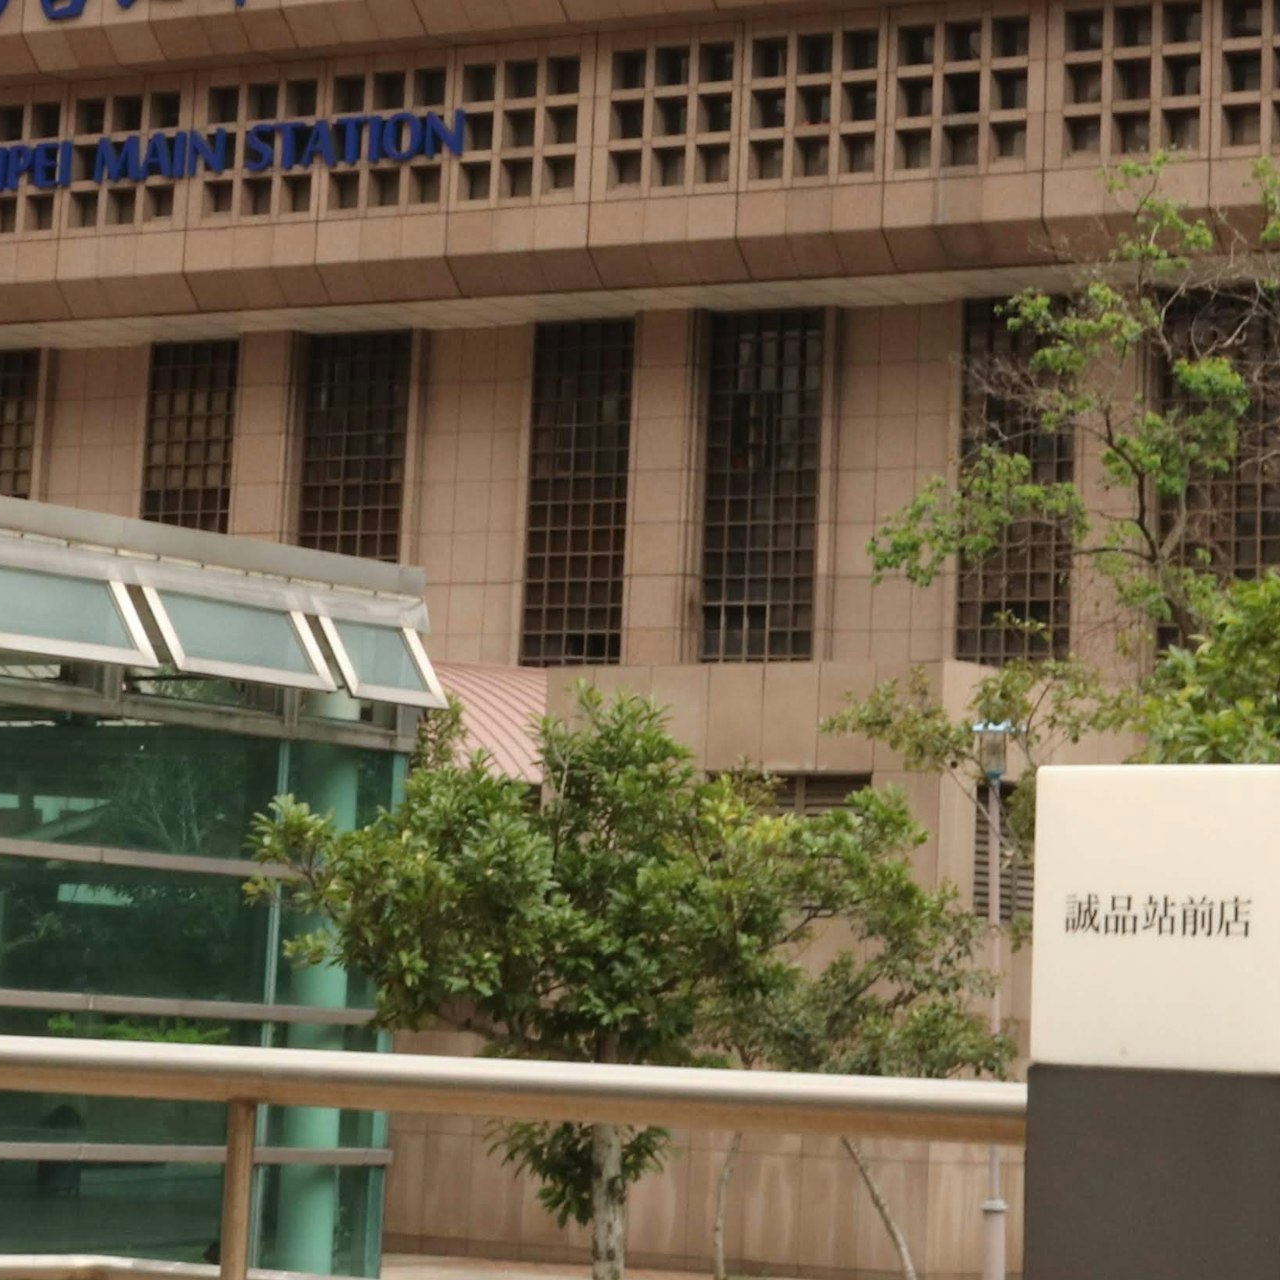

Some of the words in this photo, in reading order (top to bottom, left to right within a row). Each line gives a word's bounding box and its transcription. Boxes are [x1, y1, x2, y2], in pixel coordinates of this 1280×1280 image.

[93, 127, 226, 183] MAIN
[244, 108, 465, 171] STATION
[1064, 892, 1254, 938] 誠品站前店
